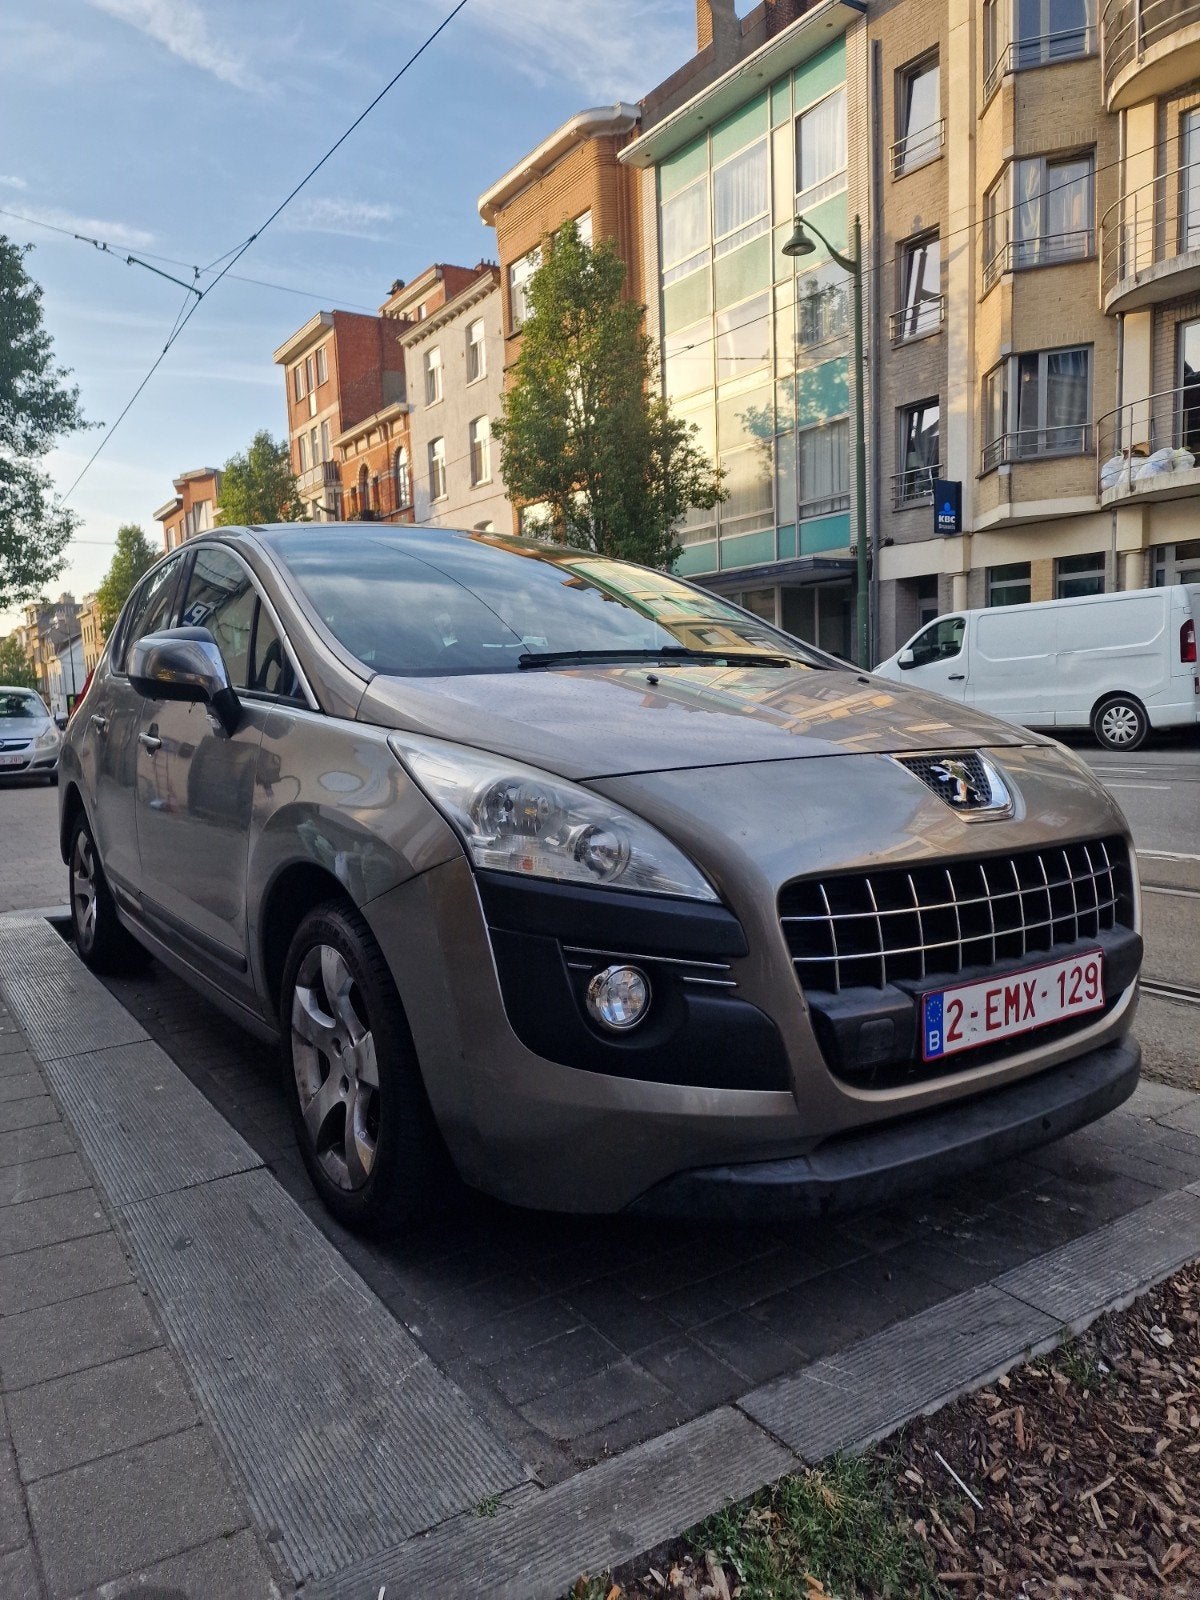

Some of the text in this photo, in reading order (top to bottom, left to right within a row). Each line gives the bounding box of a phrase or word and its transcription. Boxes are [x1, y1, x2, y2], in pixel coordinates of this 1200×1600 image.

[938, 515, 956, 523] KBC
[946, 962, 1099, 1043] 2-EMX-129
[928, 1030, 940, 1051] B
